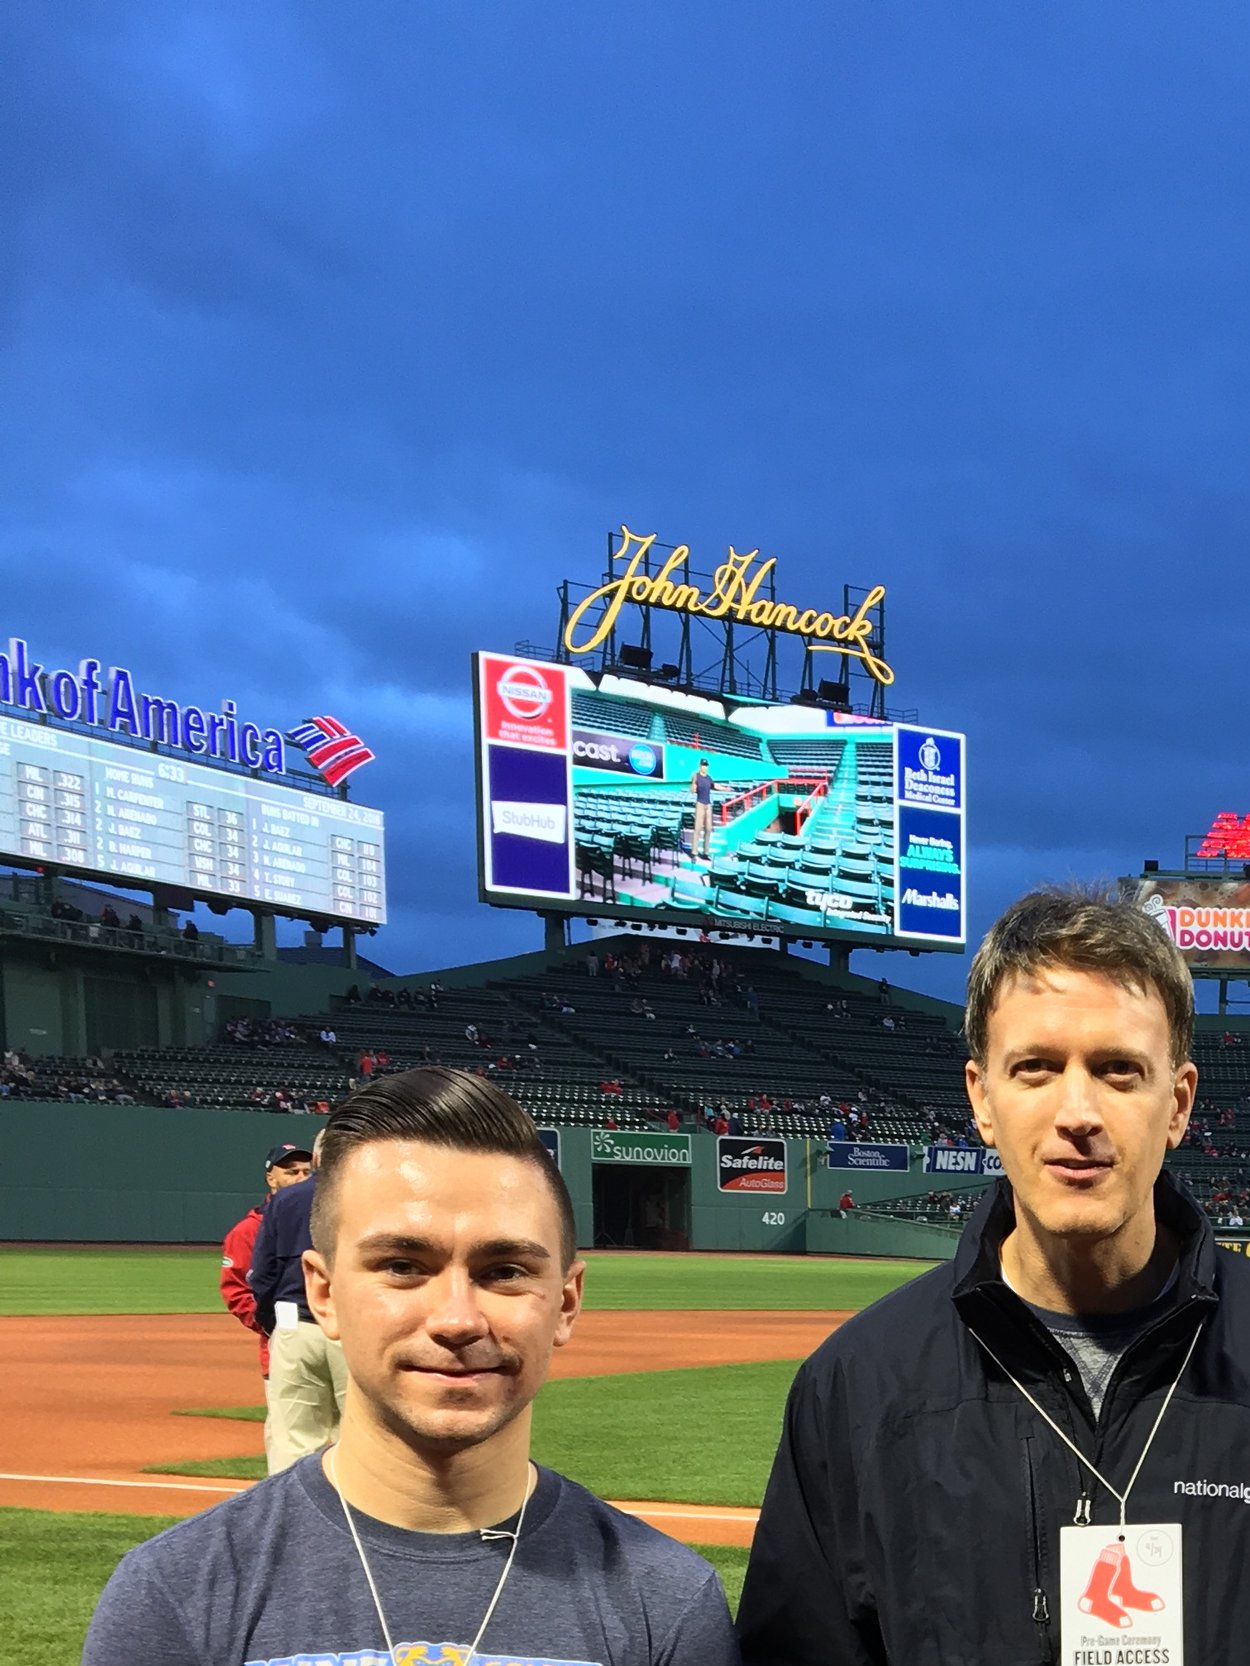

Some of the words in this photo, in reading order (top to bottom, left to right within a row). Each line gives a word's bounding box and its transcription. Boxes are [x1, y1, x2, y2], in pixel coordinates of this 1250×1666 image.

[564, 525, 700, 653] John
[696, 544, 894, 686] Hancock
[502, 685, 547, 700] NISSAN
[51, 658, 102, 726] of
[107, 666, 287, 776] America
[157, 762, 185, 783] 6:33
[903, 767, 928, 783] Beth
[928, 770, 956, 787] Israel
[903, 779, 956, 798] Deaconess
[904, 789, 932, 803] Medical
[932, 793, 956, 806] Center
[192, 805, 211, 820] STL
[502, 810, 556, 830] StubHub
[906, 843, 955, 864] ALWAYS
[804, 890, 853, 911] tyco
[901, 887, 960, 911] Marshalls
[713, 918, 752, 933] MITSUBISHI
[752, 922, 785, 934] ELECTRIC
[613, 1144, 690, 1162] sunovion
[847, 1154, 891, 1167] Scientific
[853, 1147, 881, 1159] Boston
[935, 1150, 977, 1171] NESN
[720, 1155, 784, 1171] Safelite
[987, 1155, 1003, 1170] CO
[738, 1178, 785, 1190] AutoGlass
[762, 1212, 786, 1225] 420
[1081, 1634, 1120, 1647] Pre-Game
[1121, 1634, 1162, 1647] Ceremony
[1074, 1650, 1113, 1666] FIELD
[1115, 1648, 1170, 1665] ACCESS
